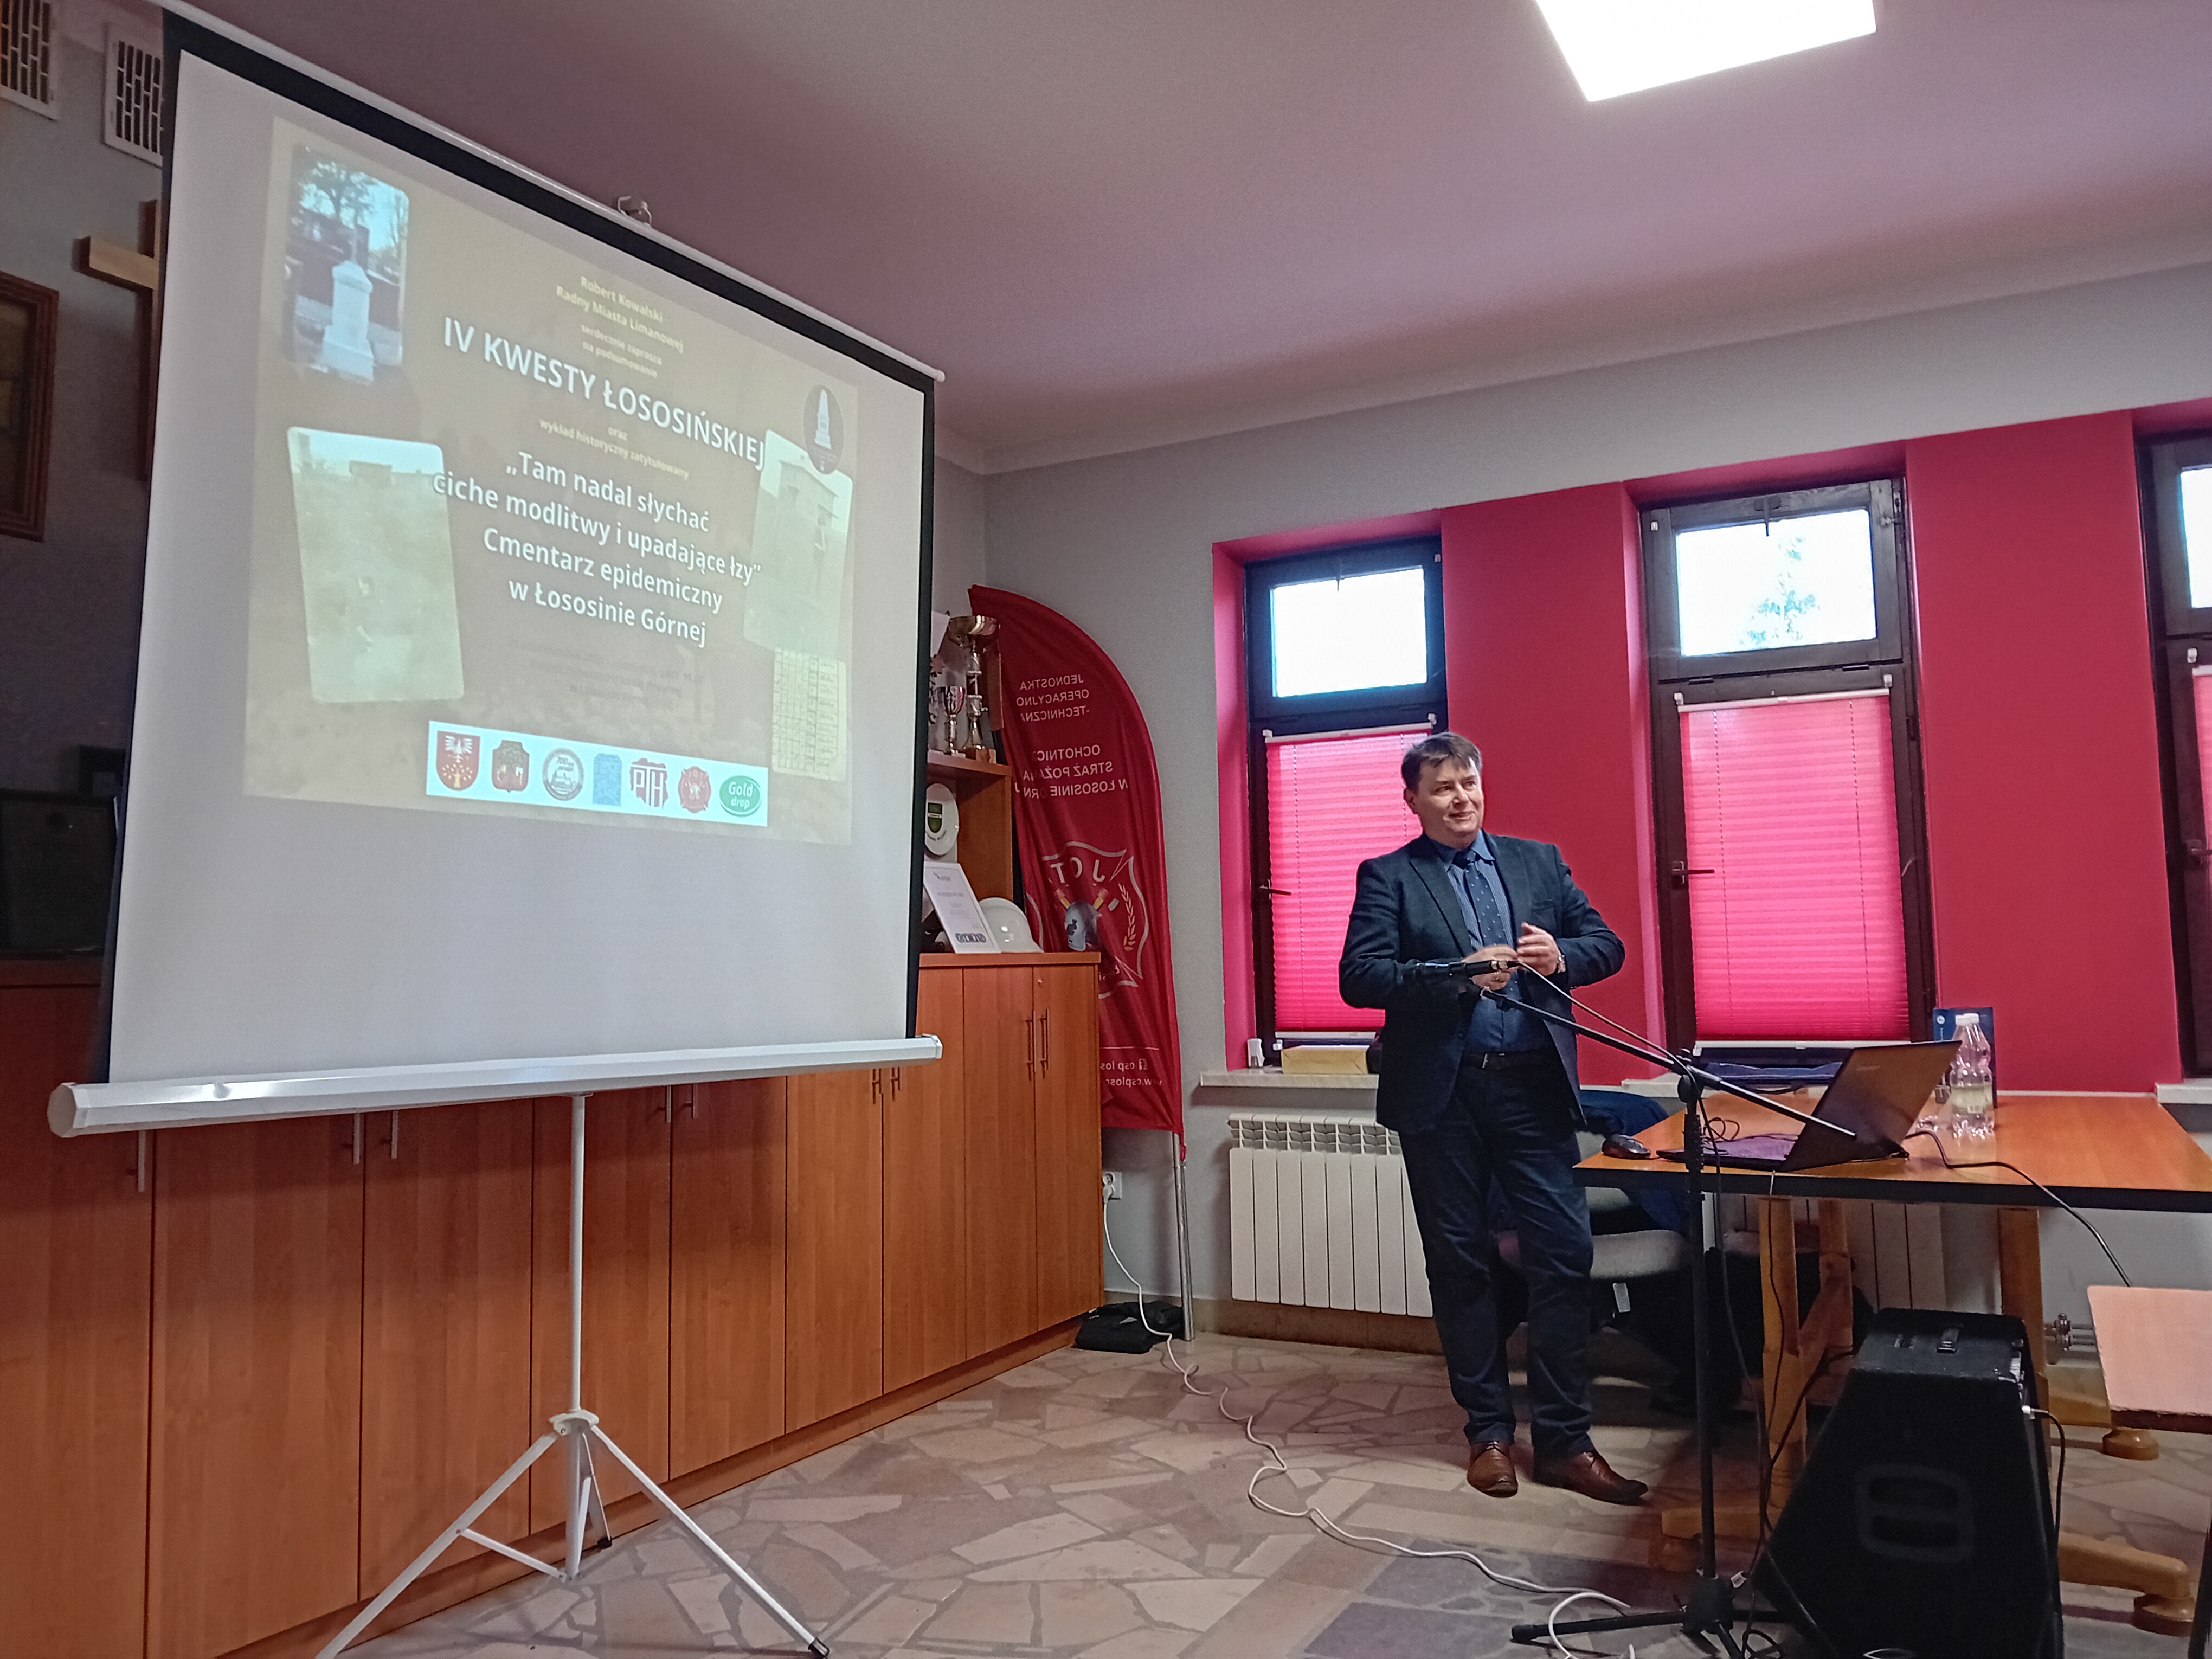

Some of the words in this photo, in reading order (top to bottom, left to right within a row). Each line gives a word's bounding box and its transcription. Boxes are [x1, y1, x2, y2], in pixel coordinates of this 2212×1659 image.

[557, 285, 590, 313] Radny
[593, 301, 627, 326] Miasta
[629, 318, 683, 354] Limanowej
[581, 275, 616, 303] Robert
[618, 293, 663, 323] Kowalski
[445, 317, 475, 353] IV
[485, 332, 596, 400] KWESTY
[602, 379, 764, 471] ŁOSOSIŃSKIEJ
[539, 420, 575, 439] wykład
[576, 429, 629, 460] historyczny
[630, 451, 690, 480] zatytułowany
[608, 427, 628, 441] oraz
[433, 471, 498, 509] ciche
[506, 494, 610, 545] modlitwy
[616, 522, 621, 544] i
[628, 531, 725, 574] upadające
[574, 474, 632, 508] nadal
[638, 492, 709, 532] słychać
[484, 528, 594, 577] Cmentarz
[601, 563, 723, 614] epidemiczny
[509, 581, 529, 601] w
[535, 582, 635, 626] Łososinie
[641, 608, 706, 648] Górnej
[729, 781, 753, 797] Gold
[731, 796, 750, 809] drop
